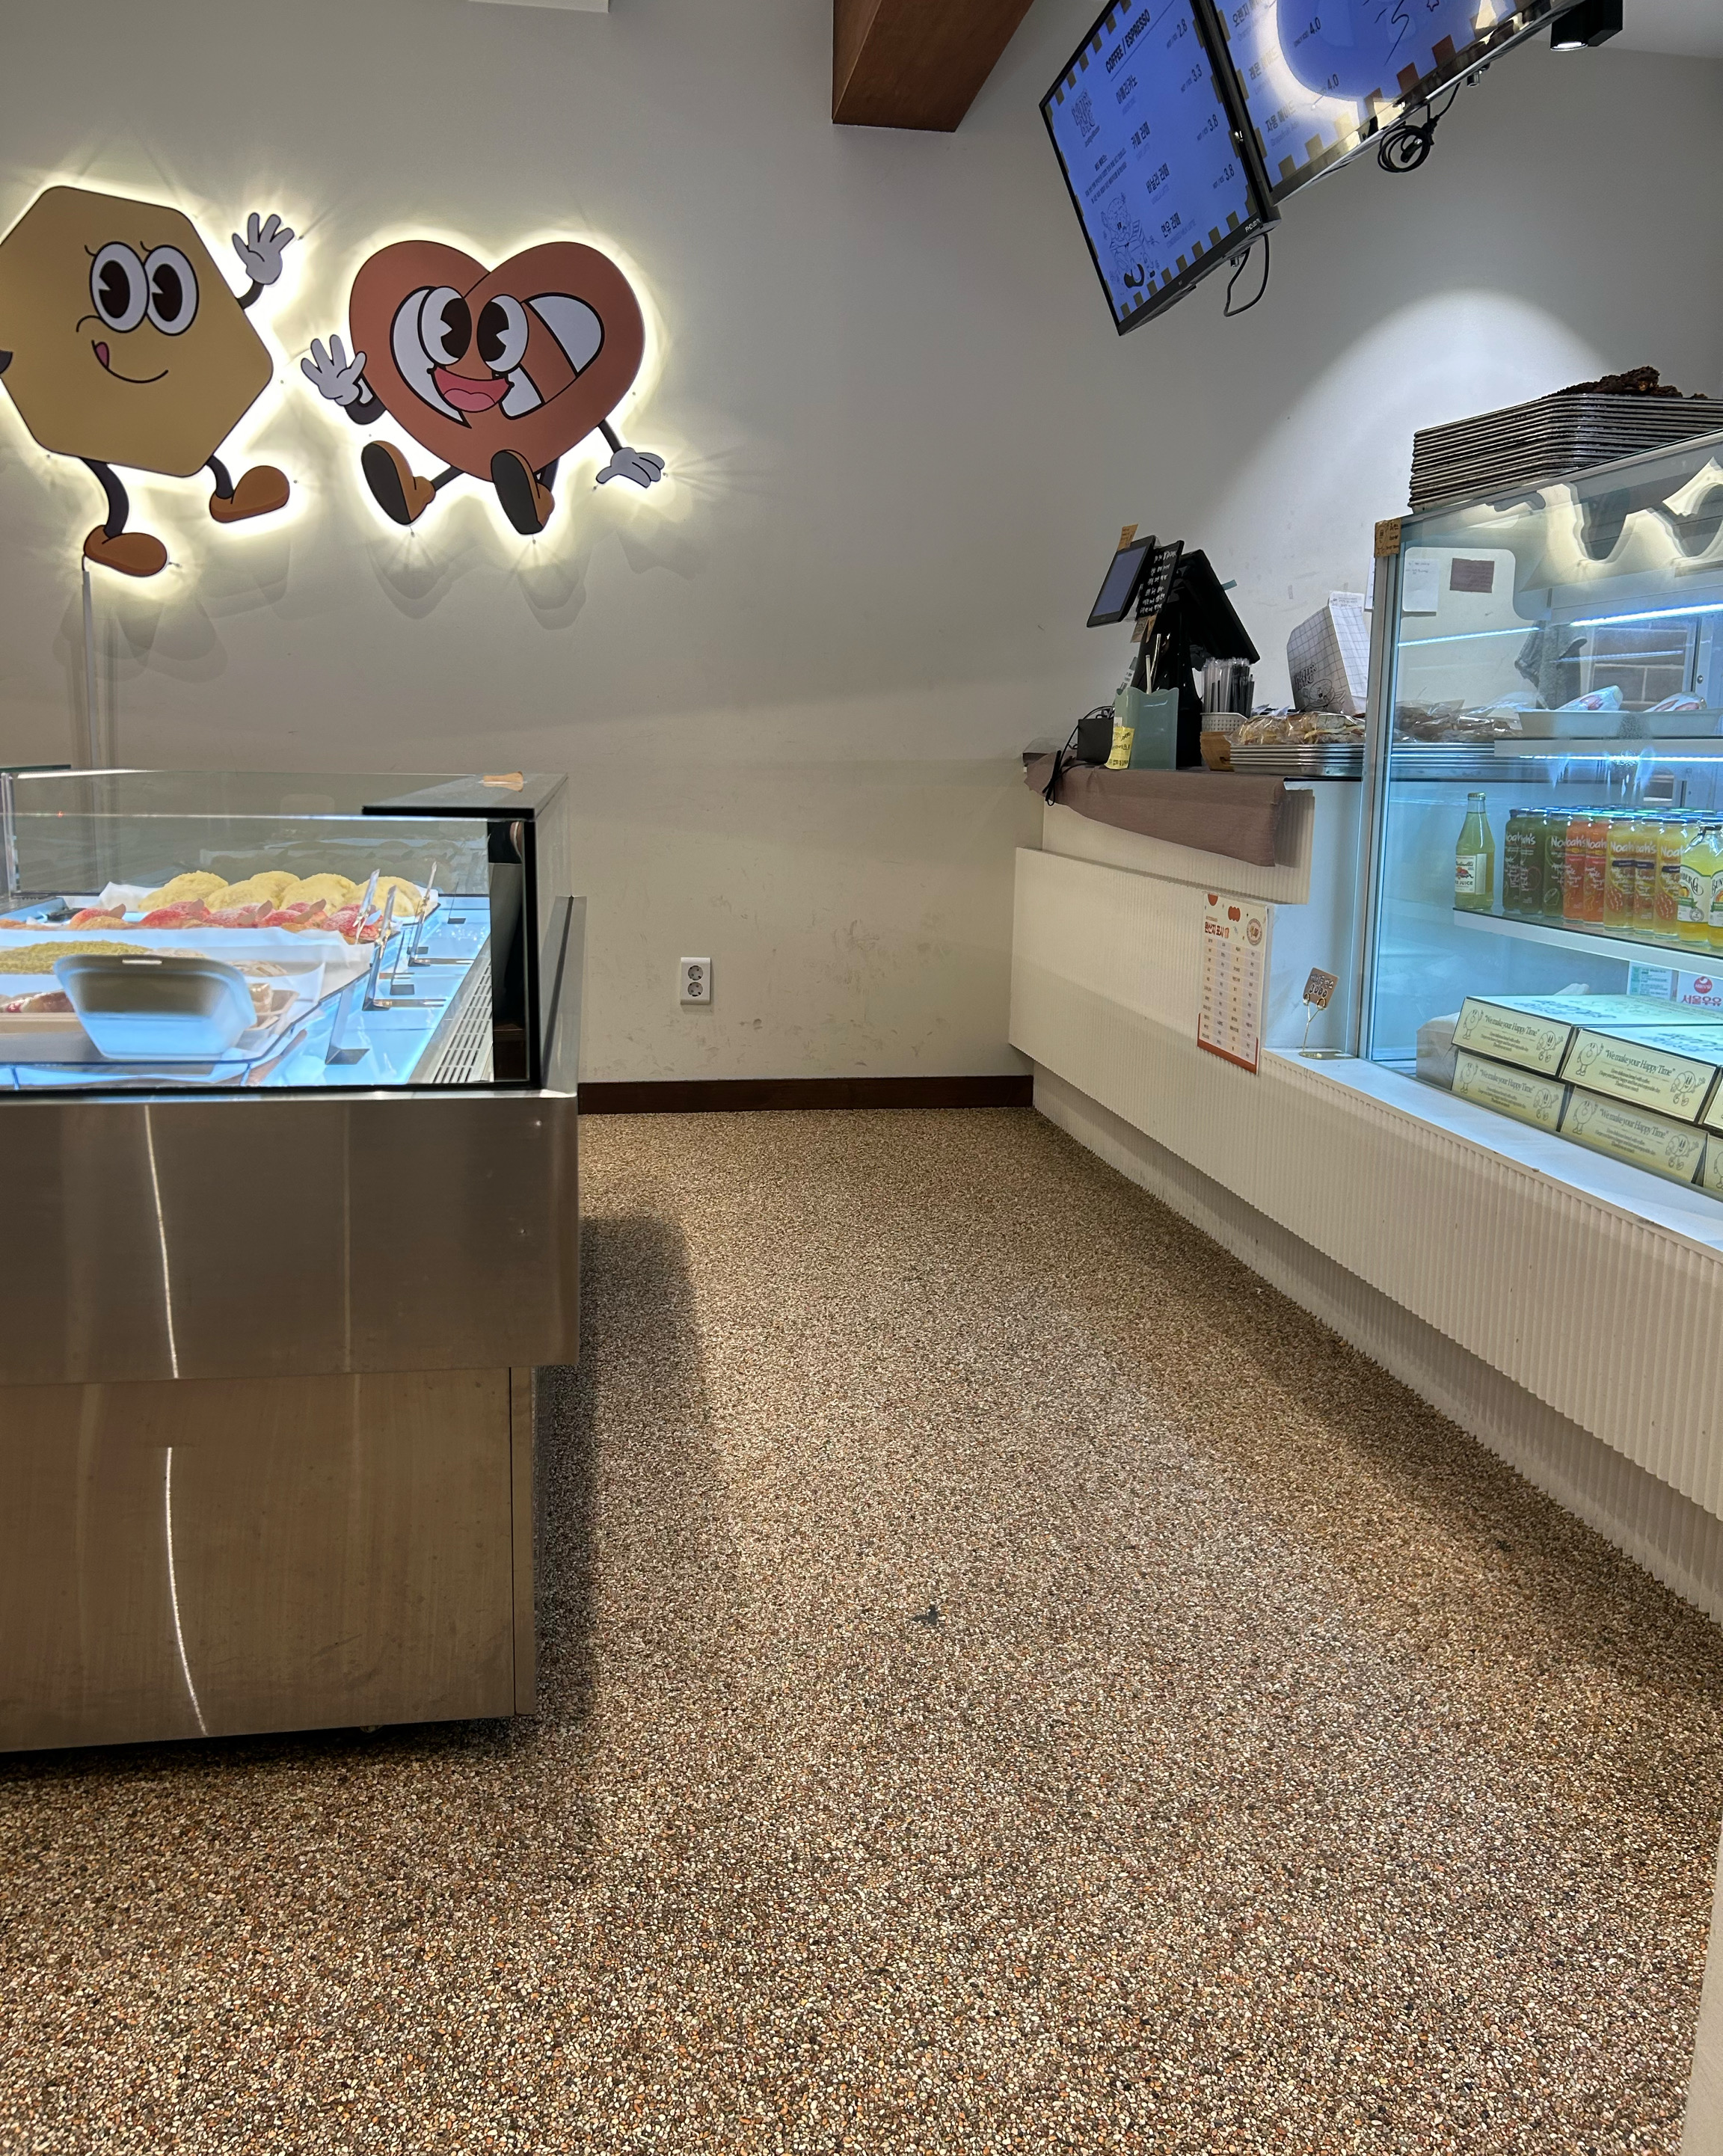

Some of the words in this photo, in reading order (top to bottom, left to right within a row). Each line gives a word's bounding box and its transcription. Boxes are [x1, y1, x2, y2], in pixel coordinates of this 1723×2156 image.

[1232, 3, 1250, 28] 오렌지
[1177, 18, 1188, 37] 2.8
[1309, 16, 1321, 35] 4.0
[1106, 44, 1123, 73] COFFEE
[1125, 8, 1150, 48] ESPRESSO
[1191, 64, 1203, 82] 3.3
[1248, 62, 1262, 80] 레몬
[1116, 75, 1137, 104] 아메리카노
[1327, 73, 1339, 90] 4.0
[1208, 114, 1218, 132] 3.8
[1265, 114, 1278, 133] 자몽
[1131, 131, 1142, 149] 카페
[1224, 164, 1235, 181] 3.8
[1146, 172, 1160, 194] 바닐라
[1161, 221, 1171, 238] 연유
[1205, 921, 1216, 935] 원산지
[1216, 925, 1225, 939] 표시
[1681, 995, 1722, 1007] 서울우유
[1511, 1022, 1526, 1034] Happy
[1615, 1054, 1627, 1063] make
[1627, 1058, 1641, 1067] your
[1640, 1060, 1657, 1075] Happy
[1508, 1078, 1522, 1091] Happy
[1609, 1114, 1623, 1124] make
[1621, 1119, 1635, 1127] your
[1634, 1120, 1651, 1136] Happy
